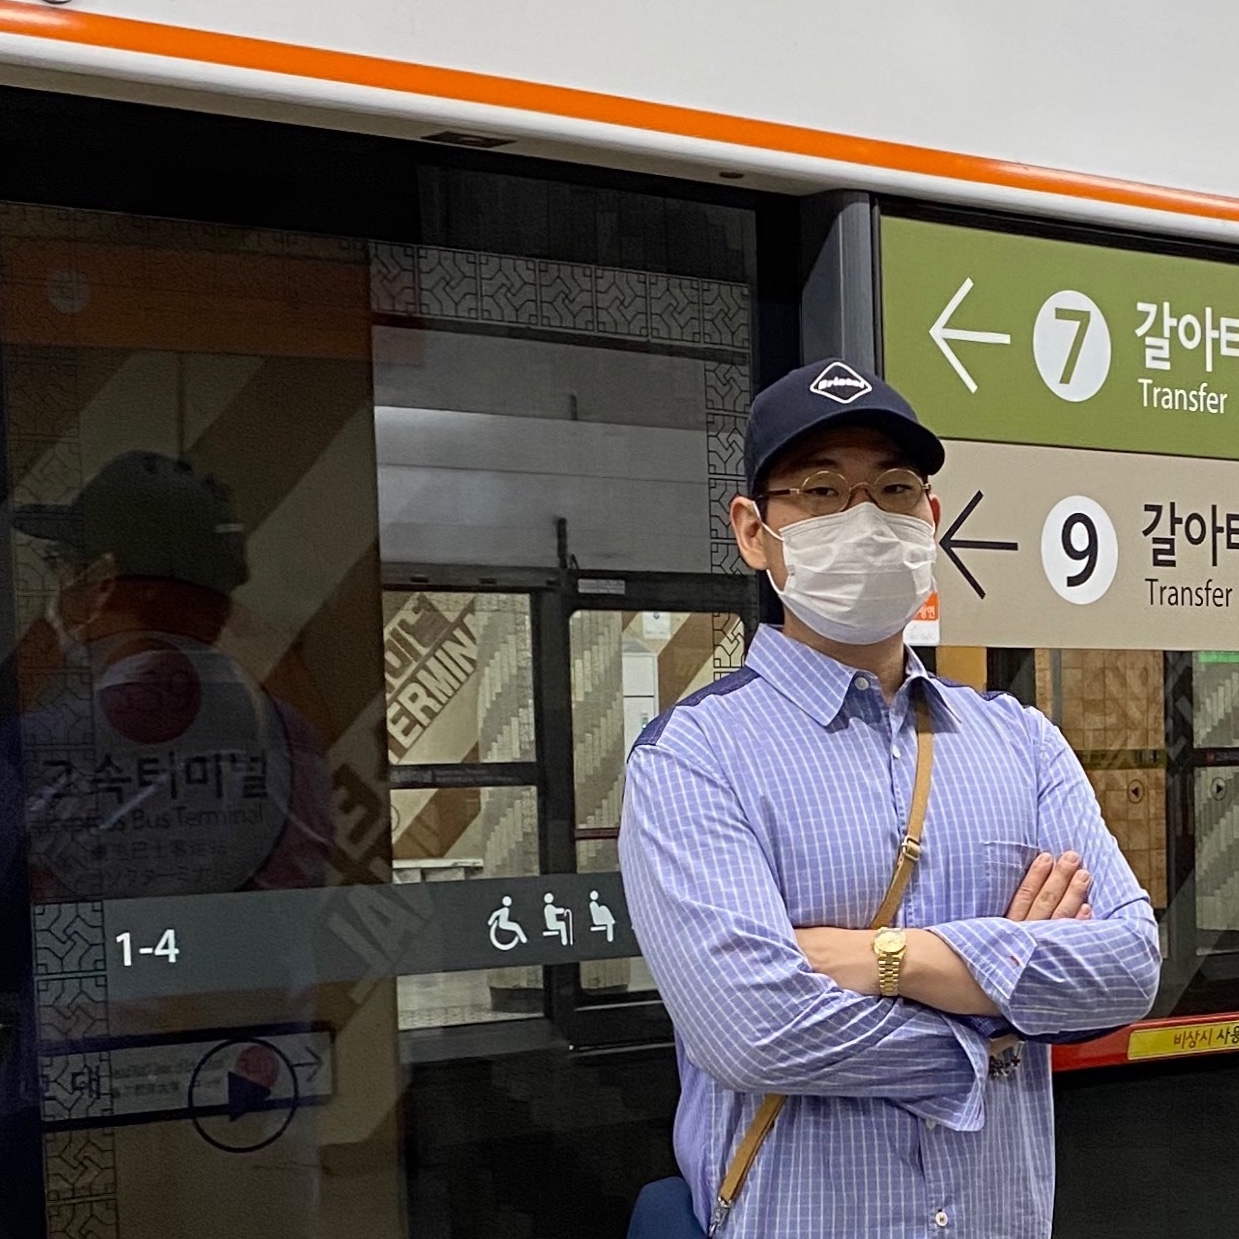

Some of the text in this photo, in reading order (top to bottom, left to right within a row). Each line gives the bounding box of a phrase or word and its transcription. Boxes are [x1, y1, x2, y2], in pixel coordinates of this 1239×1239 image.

[1055, 307, 1091, 385] 7
[1137, 378, 1228, 414] Transfer
[1061, 512, 1099, 588] 9
[1144, 578, 1233, 608] Transfer
[115, 929, 180, 967] 1-4
[1174, 1028, 1212, 1049] 비상시
